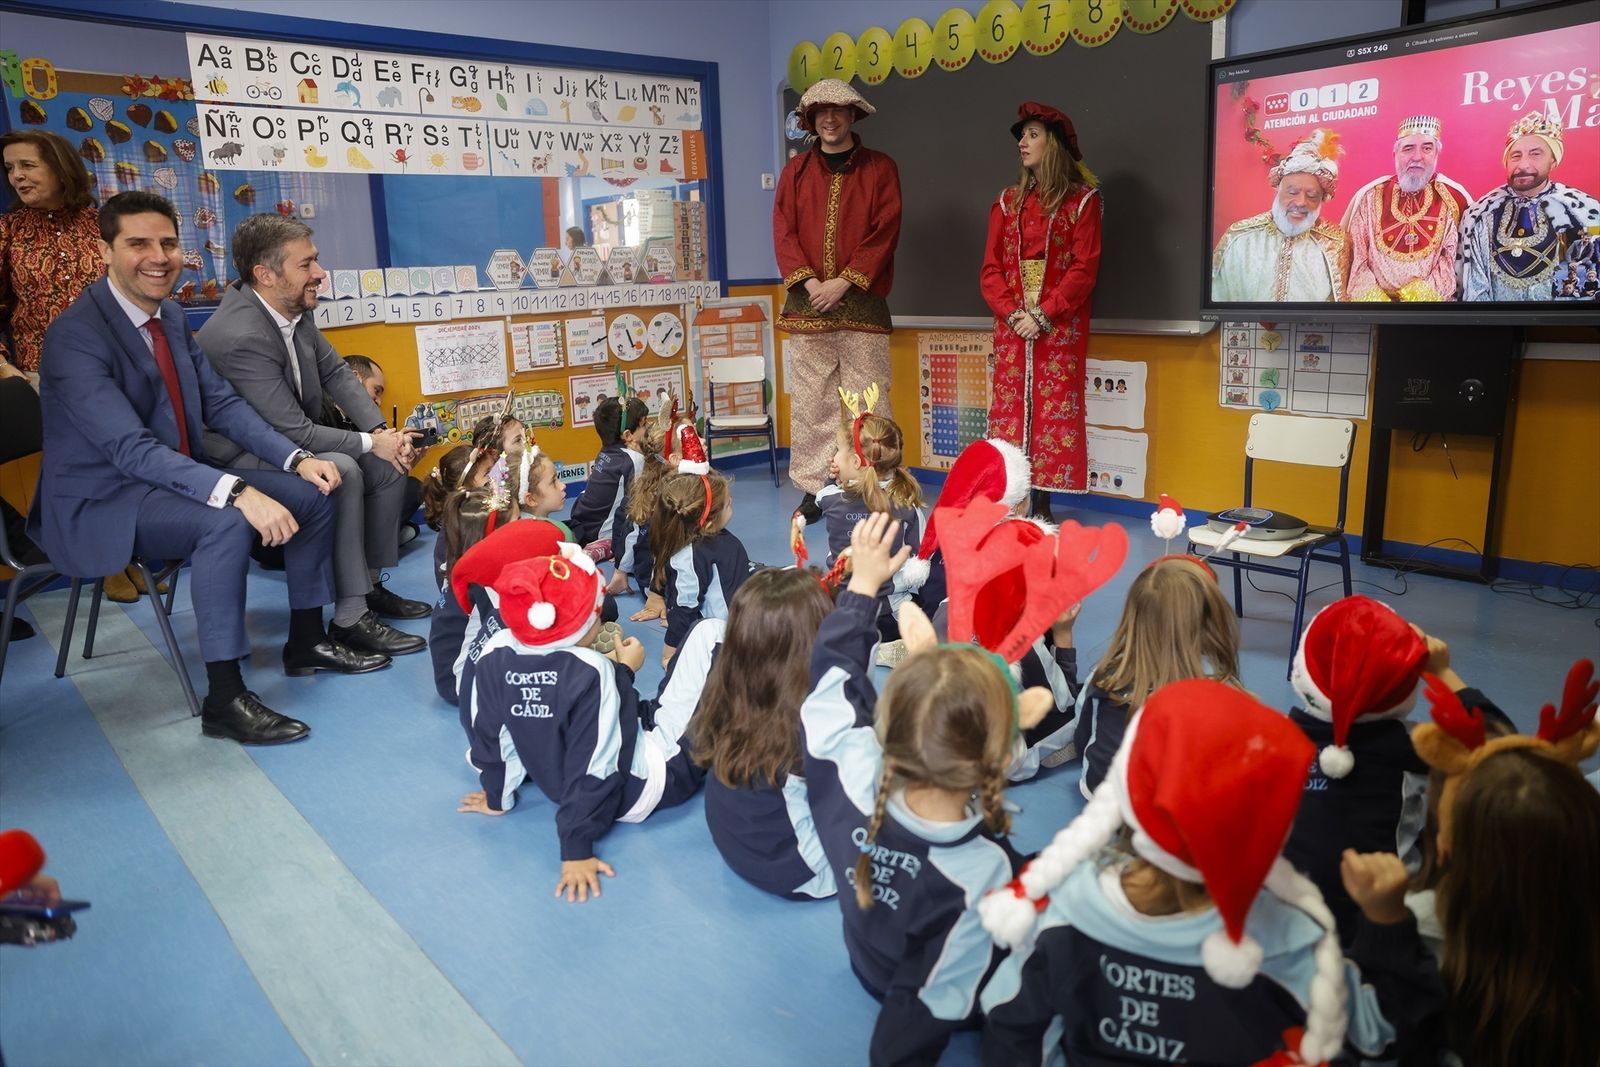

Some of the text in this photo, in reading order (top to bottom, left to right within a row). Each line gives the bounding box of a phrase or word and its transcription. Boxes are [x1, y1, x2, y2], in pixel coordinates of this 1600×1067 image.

[800, 55, 807, 78] 1
[833, 46, 843, 71] 2
[868, 42, 879, 66] 3
[906, 33, 917, 58] 4
[949, 24, 959, 51] 5
[992, 14, 1004, 42] 6
[1038, 4, 1051, 33] 7
[1357, 43, 1388, 56] S5X 24G
[1460, 67, 1587, 111] Reyes
[1264, 105, 1378, 130] ATENCIÓN AL CIUDADANO
[321, 285, 718, 323] 1 2 3 4 5 6 7 8 9 10 11 12 13 14 15 16 17 18 19 20 21
[505, 670, 558, 685] CORTES
[520, 687, 541, 701] DE
[510, 701, 554, 718] CÁDIZ
[1118, 995, 1160, 1027] DE
[1098, 1017, 1187, 1065] CÁDIZ
